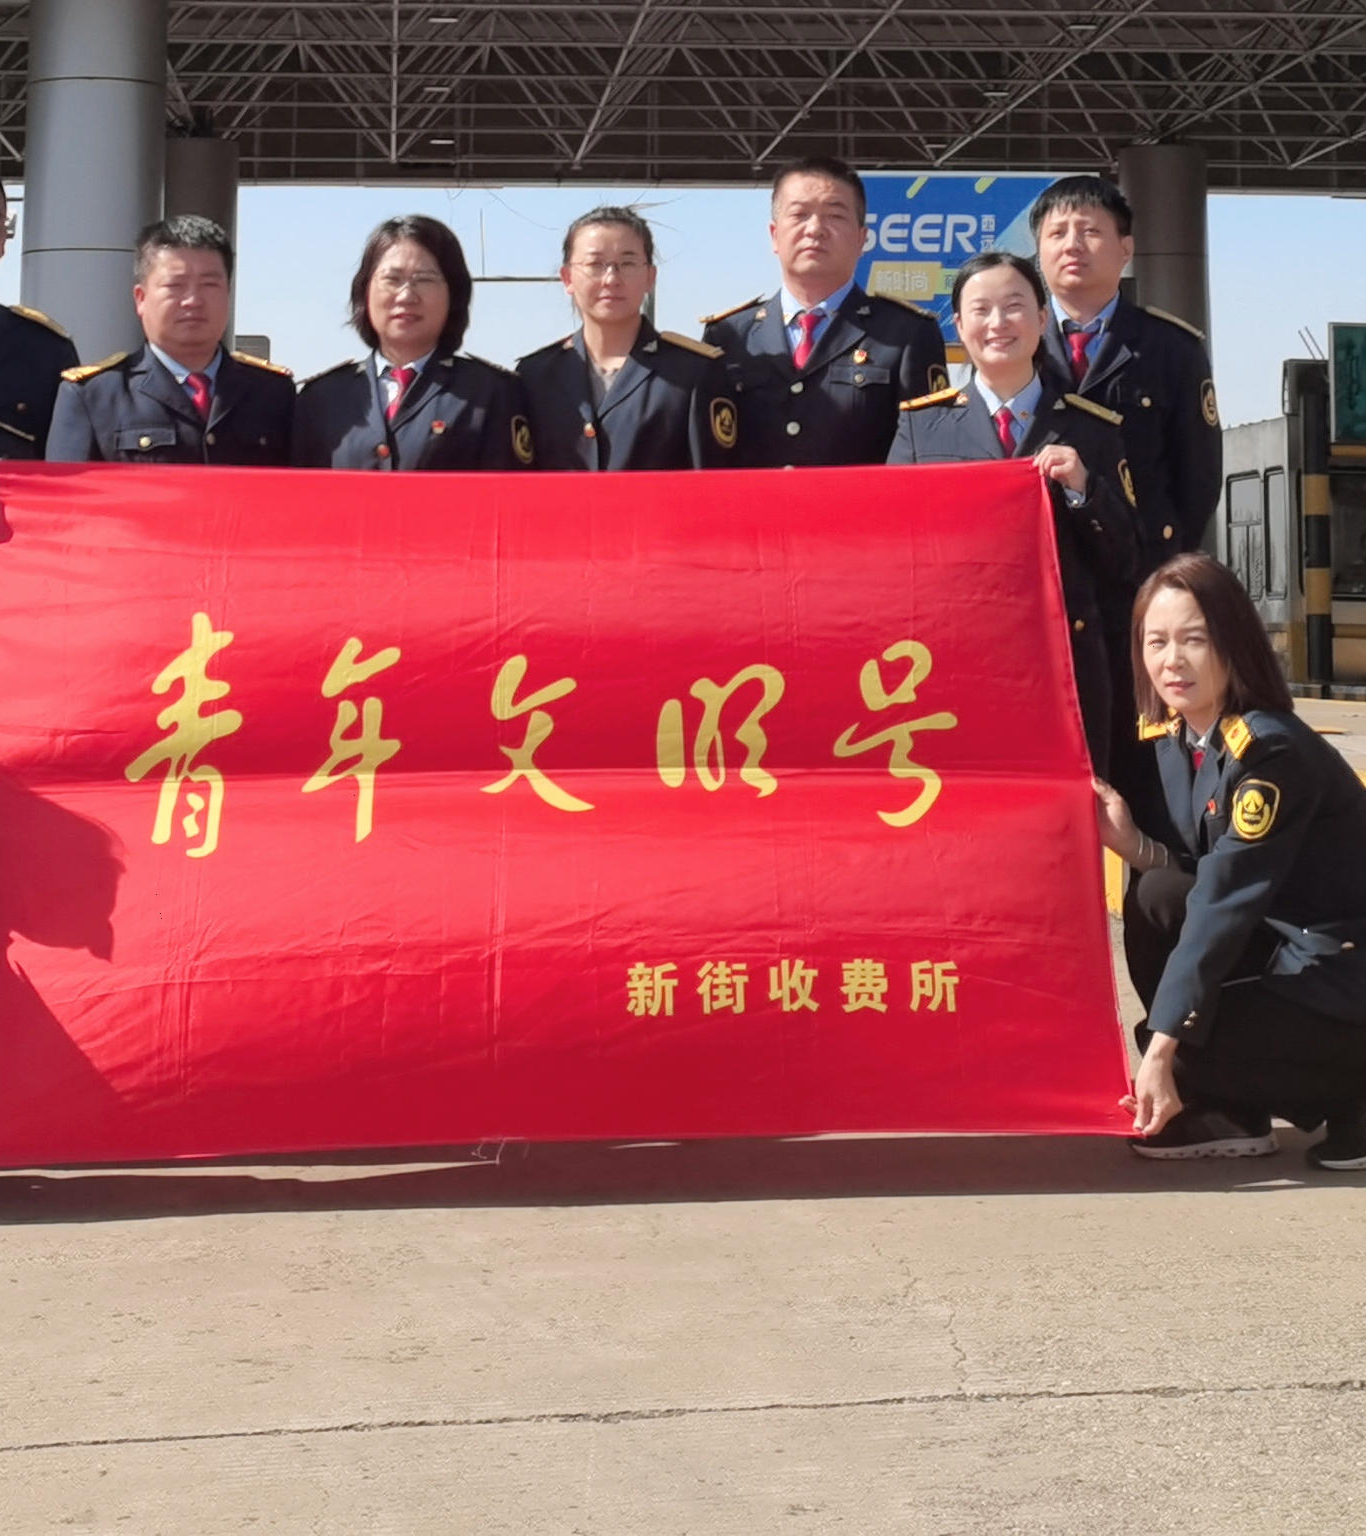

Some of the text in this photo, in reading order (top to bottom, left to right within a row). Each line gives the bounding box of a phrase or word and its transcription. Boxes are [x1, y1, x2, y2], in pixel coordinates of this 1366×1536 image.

[875, 270, 929, 292] 新时尚
[125, 612, 959, 858] 青年文明号
[625, 958, 961, 1017] 新街收费所
